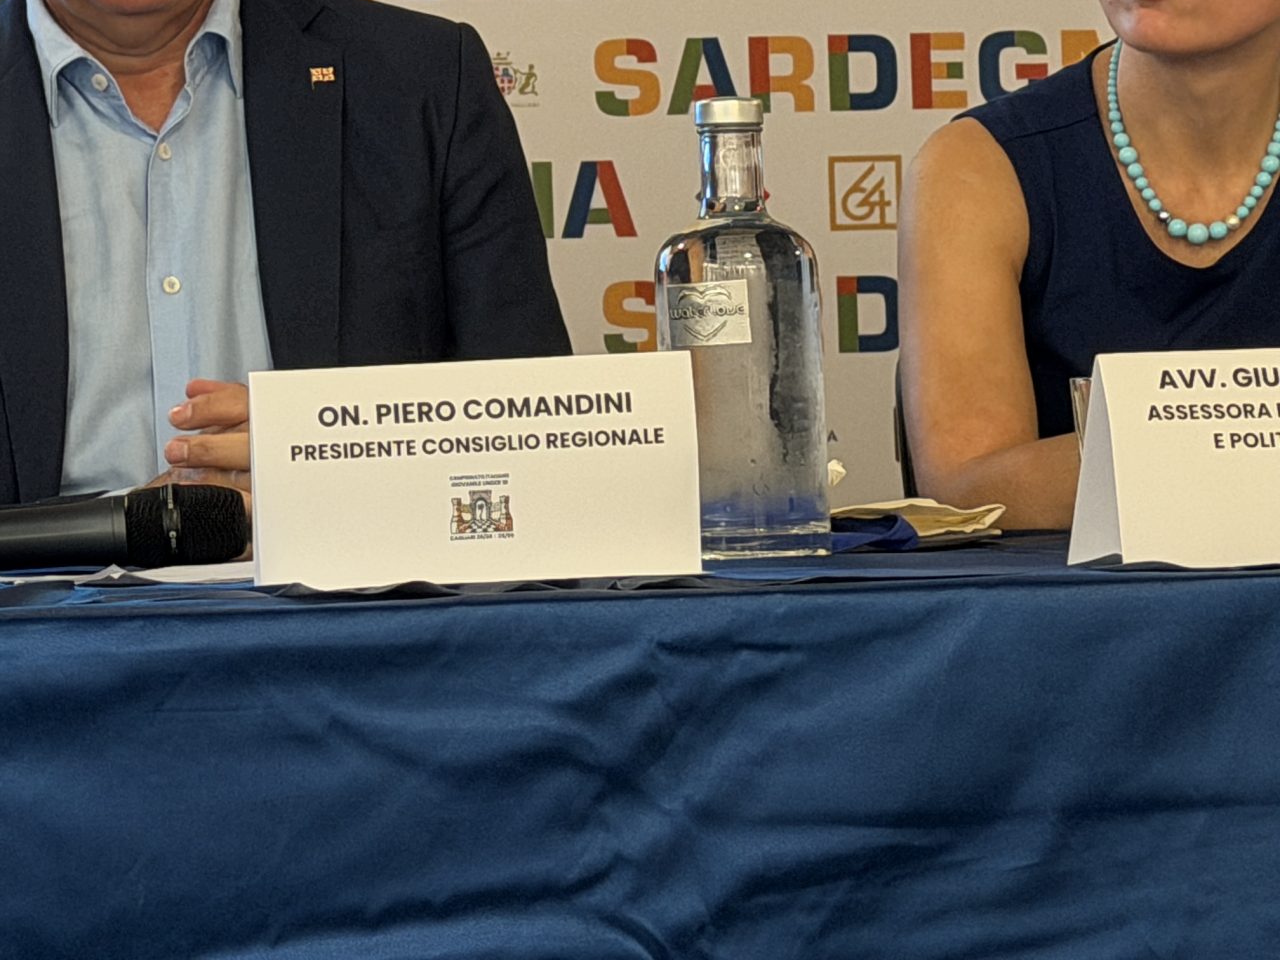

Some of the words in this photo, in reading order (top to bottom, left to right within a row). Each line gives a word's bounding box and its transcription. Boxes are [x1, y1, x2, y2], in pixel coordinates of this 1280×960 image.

[1160, 369, 1226, 389] AVV.
[1233, 368, 1280, 387] GIU
[318, 405, 368, 427] ON.
[376, 401, 456, 424] PIERO
[463, 392, 631, 420] COMANDINI
[1148, 403, 1272, 421] ASSESSORA
[291, 440, 416, 461] PRESIDENTE
[422, 434, 540, 455] CONSIGLIO
[546, 428, 664, 449] REGIONALE
[1214, 433, 1225, 448] E
